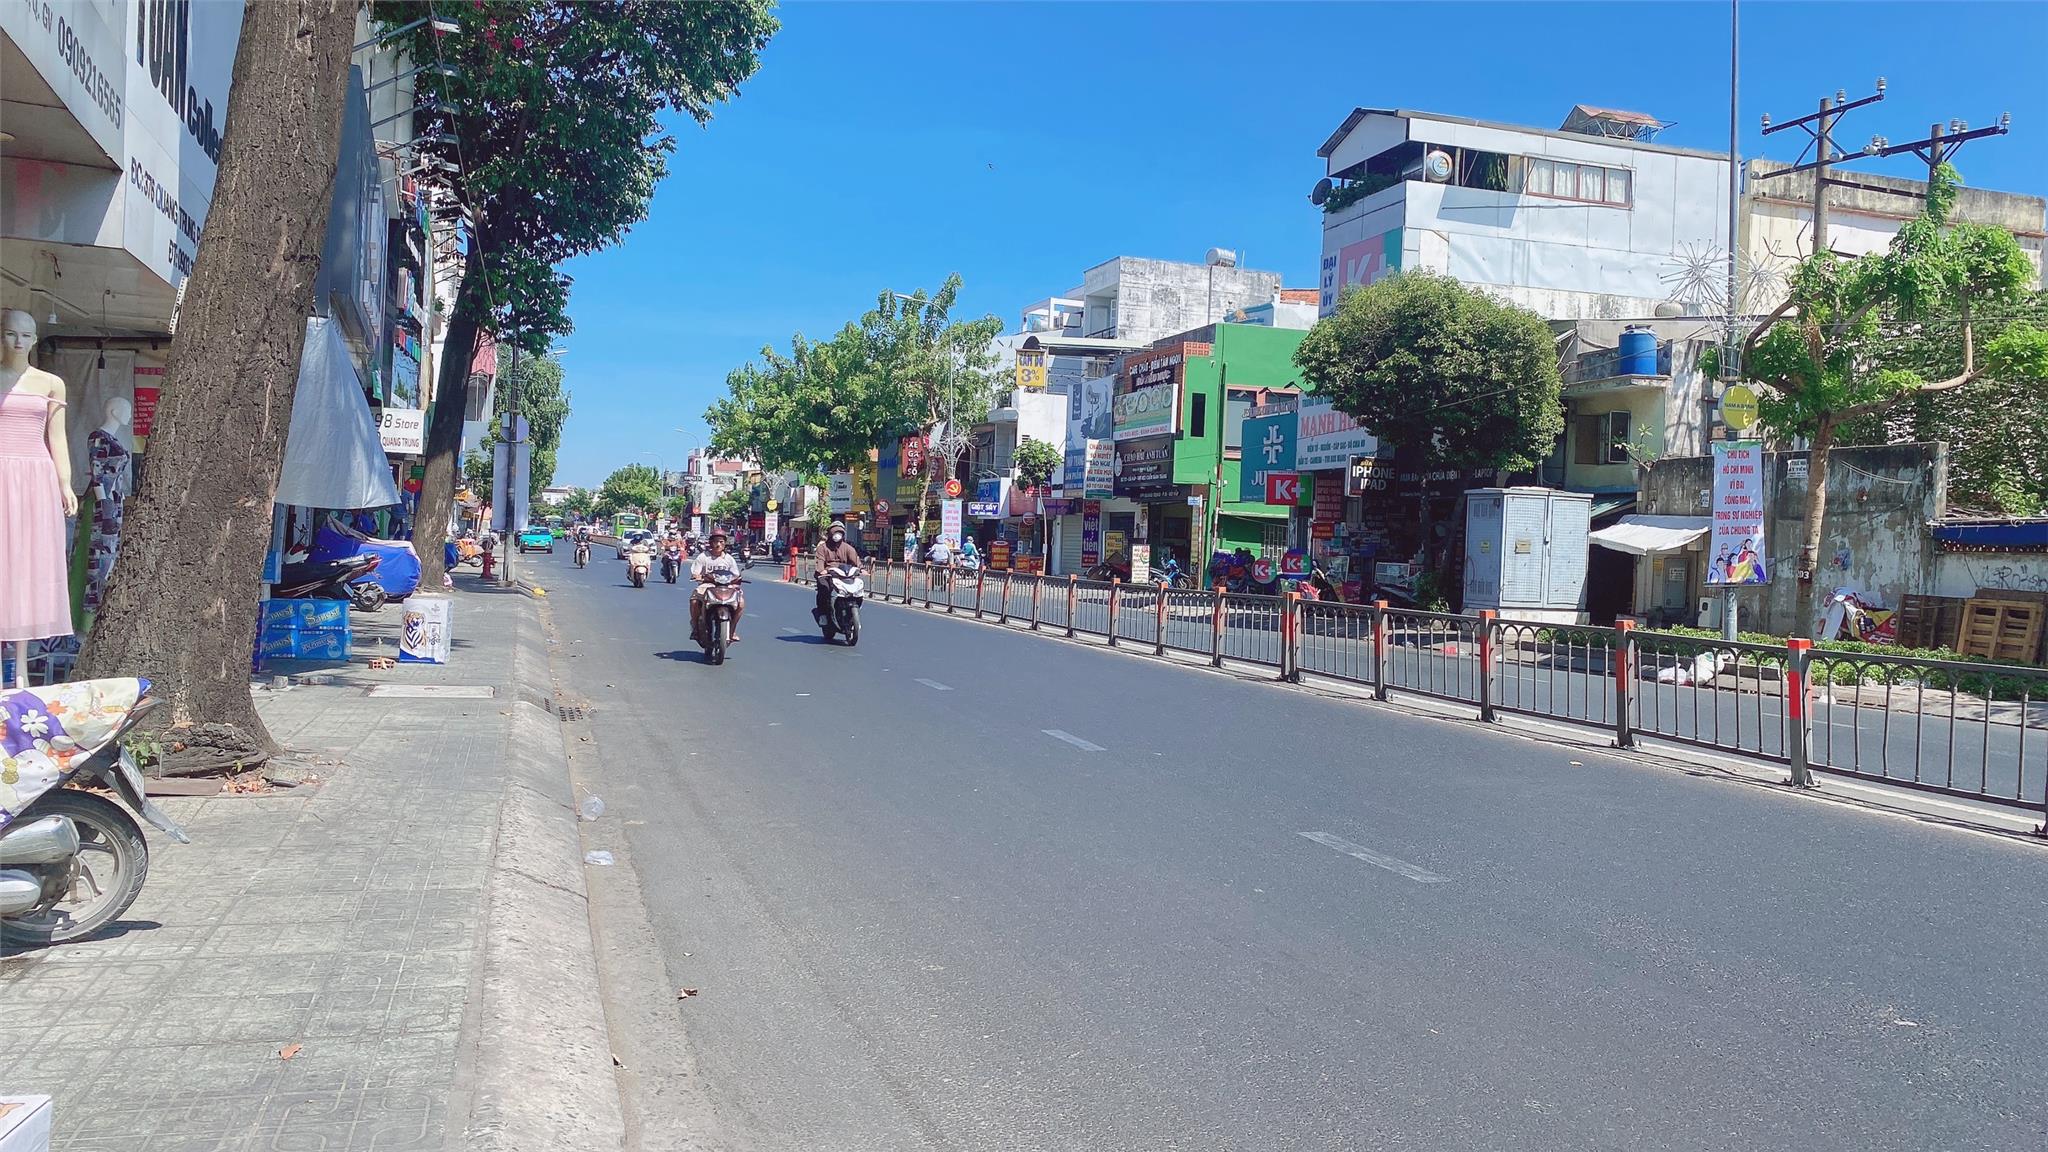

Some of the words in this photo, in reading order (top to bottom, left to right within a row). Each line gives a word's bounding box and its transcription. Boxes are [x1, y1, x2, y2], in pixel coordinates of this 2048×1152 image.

[58, 15, 121, 130] 0909216565
[155, 183, 178, 224] QUANG
[1323, 255, 1337, 272] ĐẠI
[1324, 274, 1334, 288] LÝ
[1021, 368, 1040, 382] 3%
[394, 418, 420, 430] Store
[1301, 412, 1335, 441] MẠNH
[382, 437, 401, 447] QUANG
[402, 437, 420, 448] TRUNG
[1352, 465, 1396, 480] IPHONE
[1723, 462, 1729, 474] HỒ
[1730, 464, 1738, 474] CHÍ
[1740, 465, 1754, 474] MINH
[1275, 480, 1306, 500] K+
[1360, 478, 1386, 491] IPAD
[1730, 480, 1735, 490] VĨ
[1716, 511, 1730, 520] TRONG
[1732, 510, 1740, 522] SỰ
[1741, 510, 1762, 522] NGHIỆP
[1731, 524, 1750, 535] CHÚNG
[1752, 526, 1759, 535] TA
[1254, 564, 1276, 576] K+
[1286, 558, 1307, 570] K+
